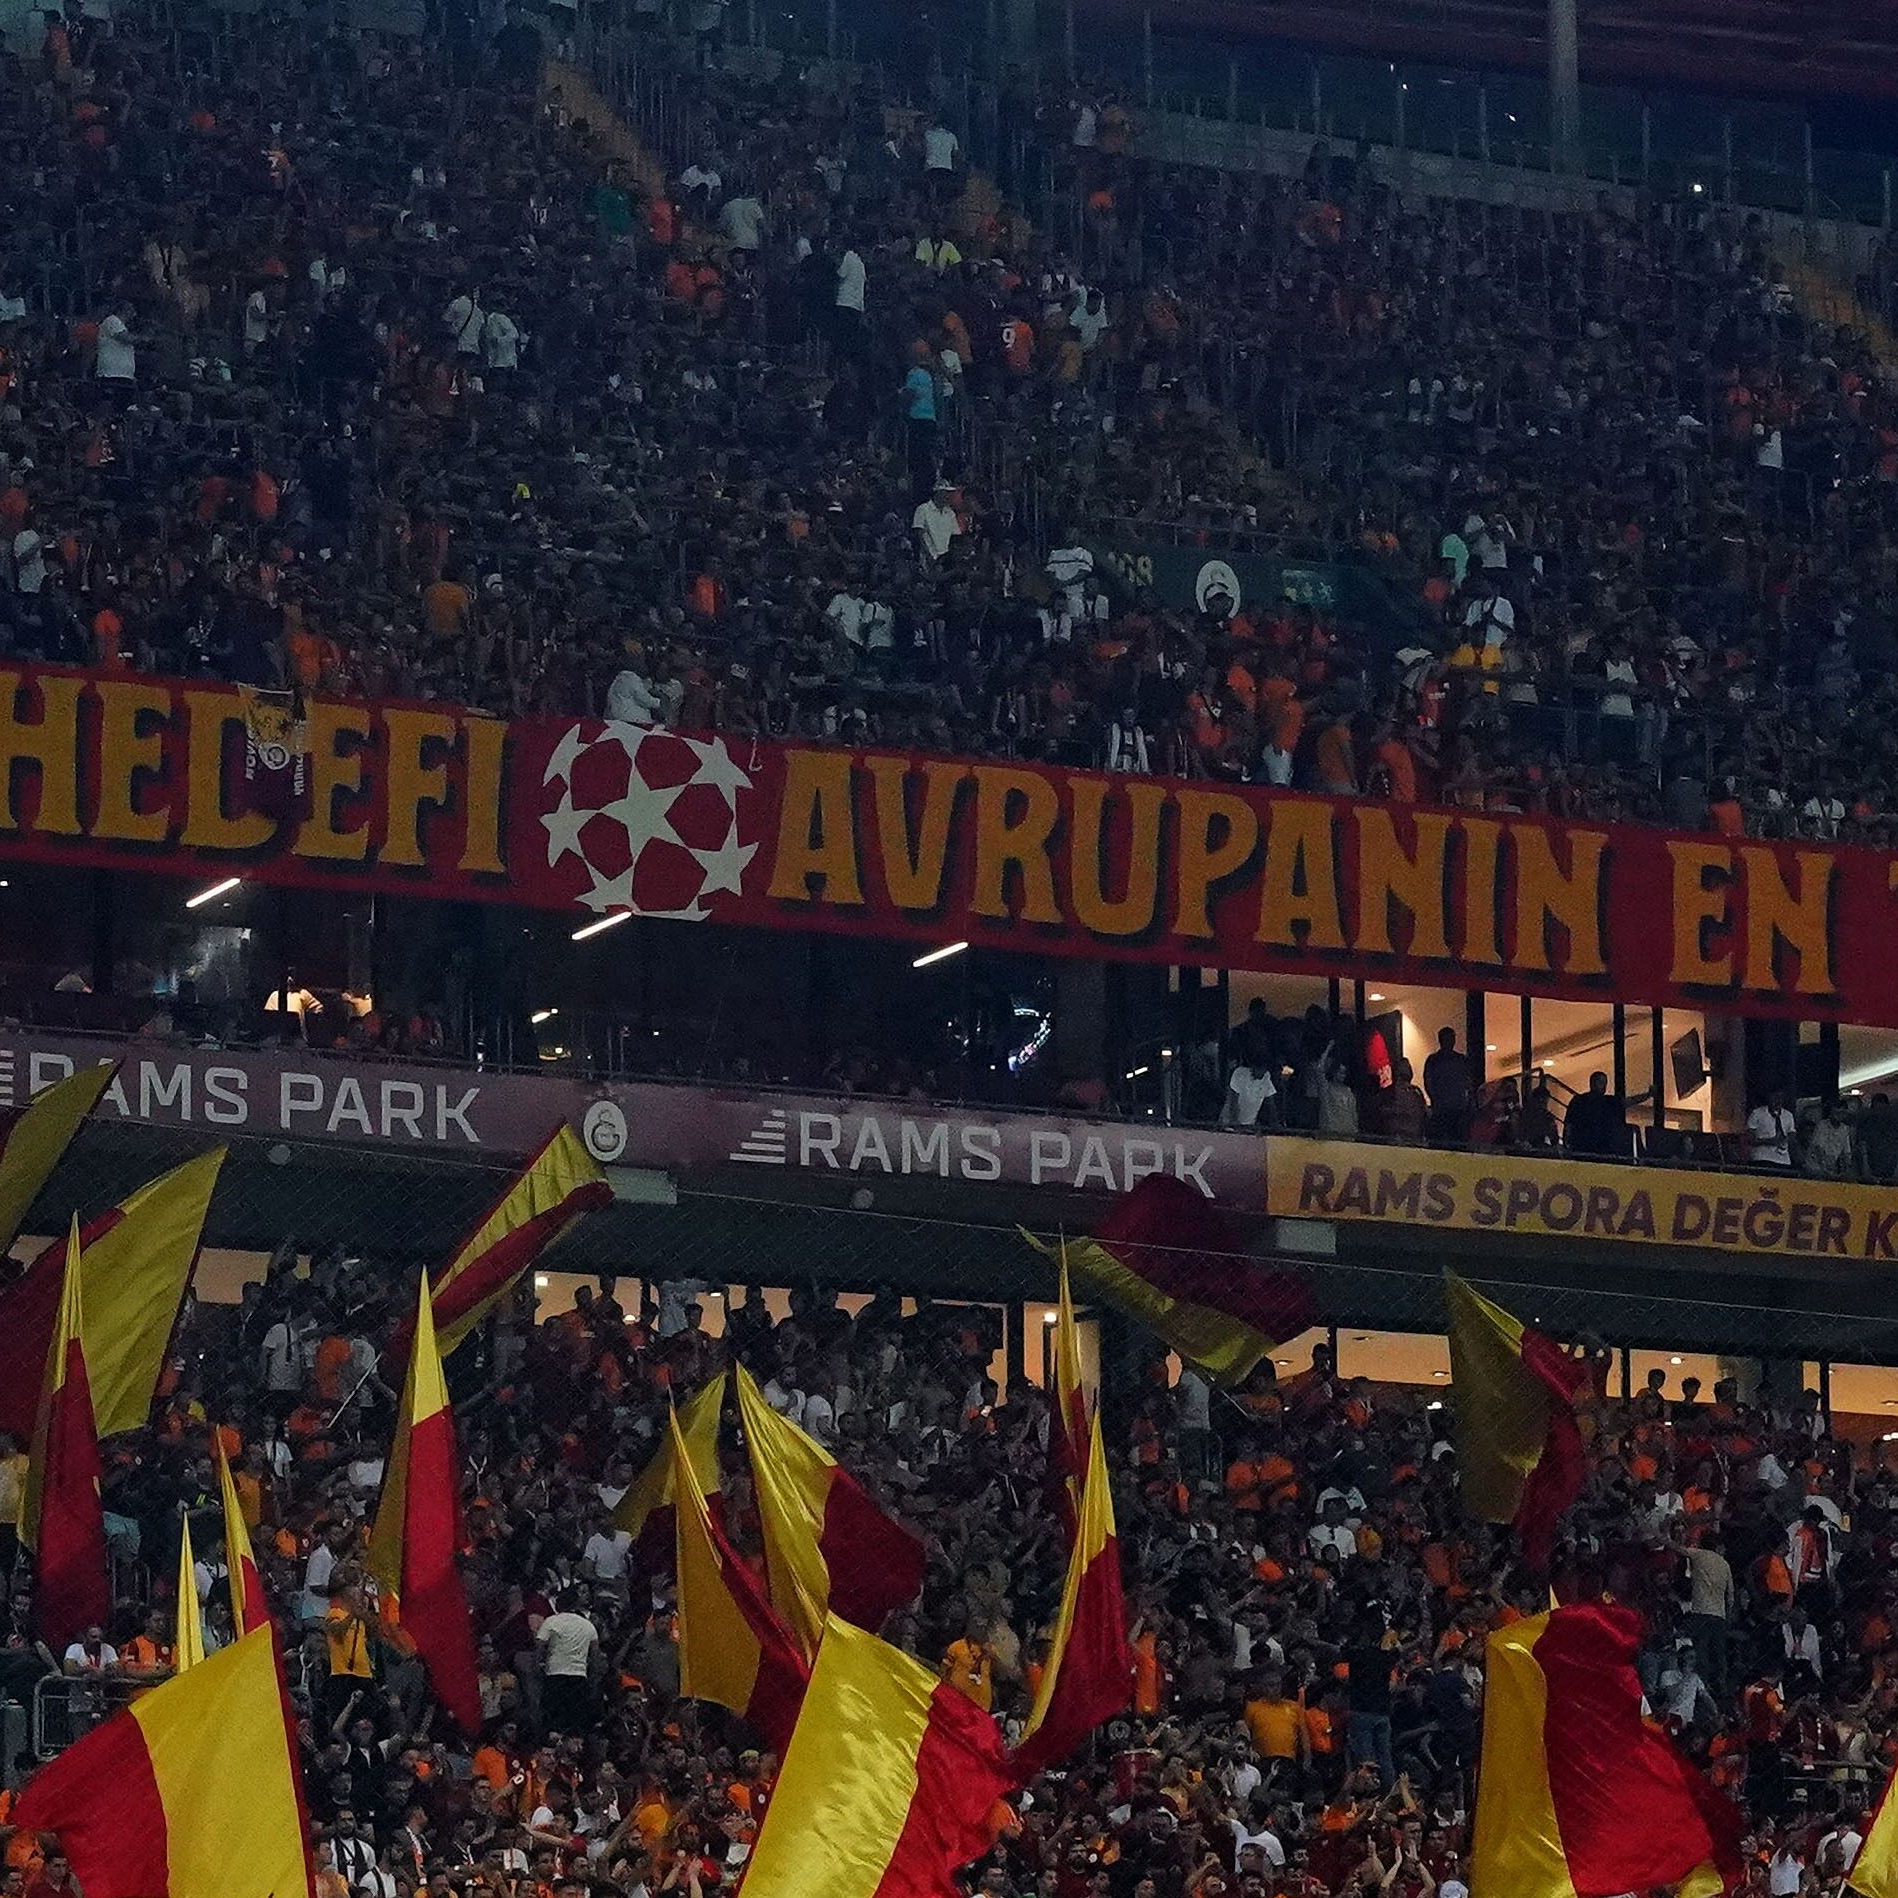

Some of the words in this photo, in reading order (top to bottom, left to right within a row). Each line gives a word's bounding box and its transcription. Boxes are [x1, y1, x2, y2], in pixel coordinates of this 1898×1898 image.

[766, 749, 1611, 976] AVRUPANIN
[1669, 839, 1838, 996] EN
[280, 1072, 481, 1143] PARK
[799, 1110, 1001, 1181] RAMS
[1030, 1130, 1215, 1198] PARK
[1298, 1163, 1457, 1222] RAMS
[1469, 1176, 1657, 1240] SPORA
[1671, 1186, 1852, 1254] DEĞER
